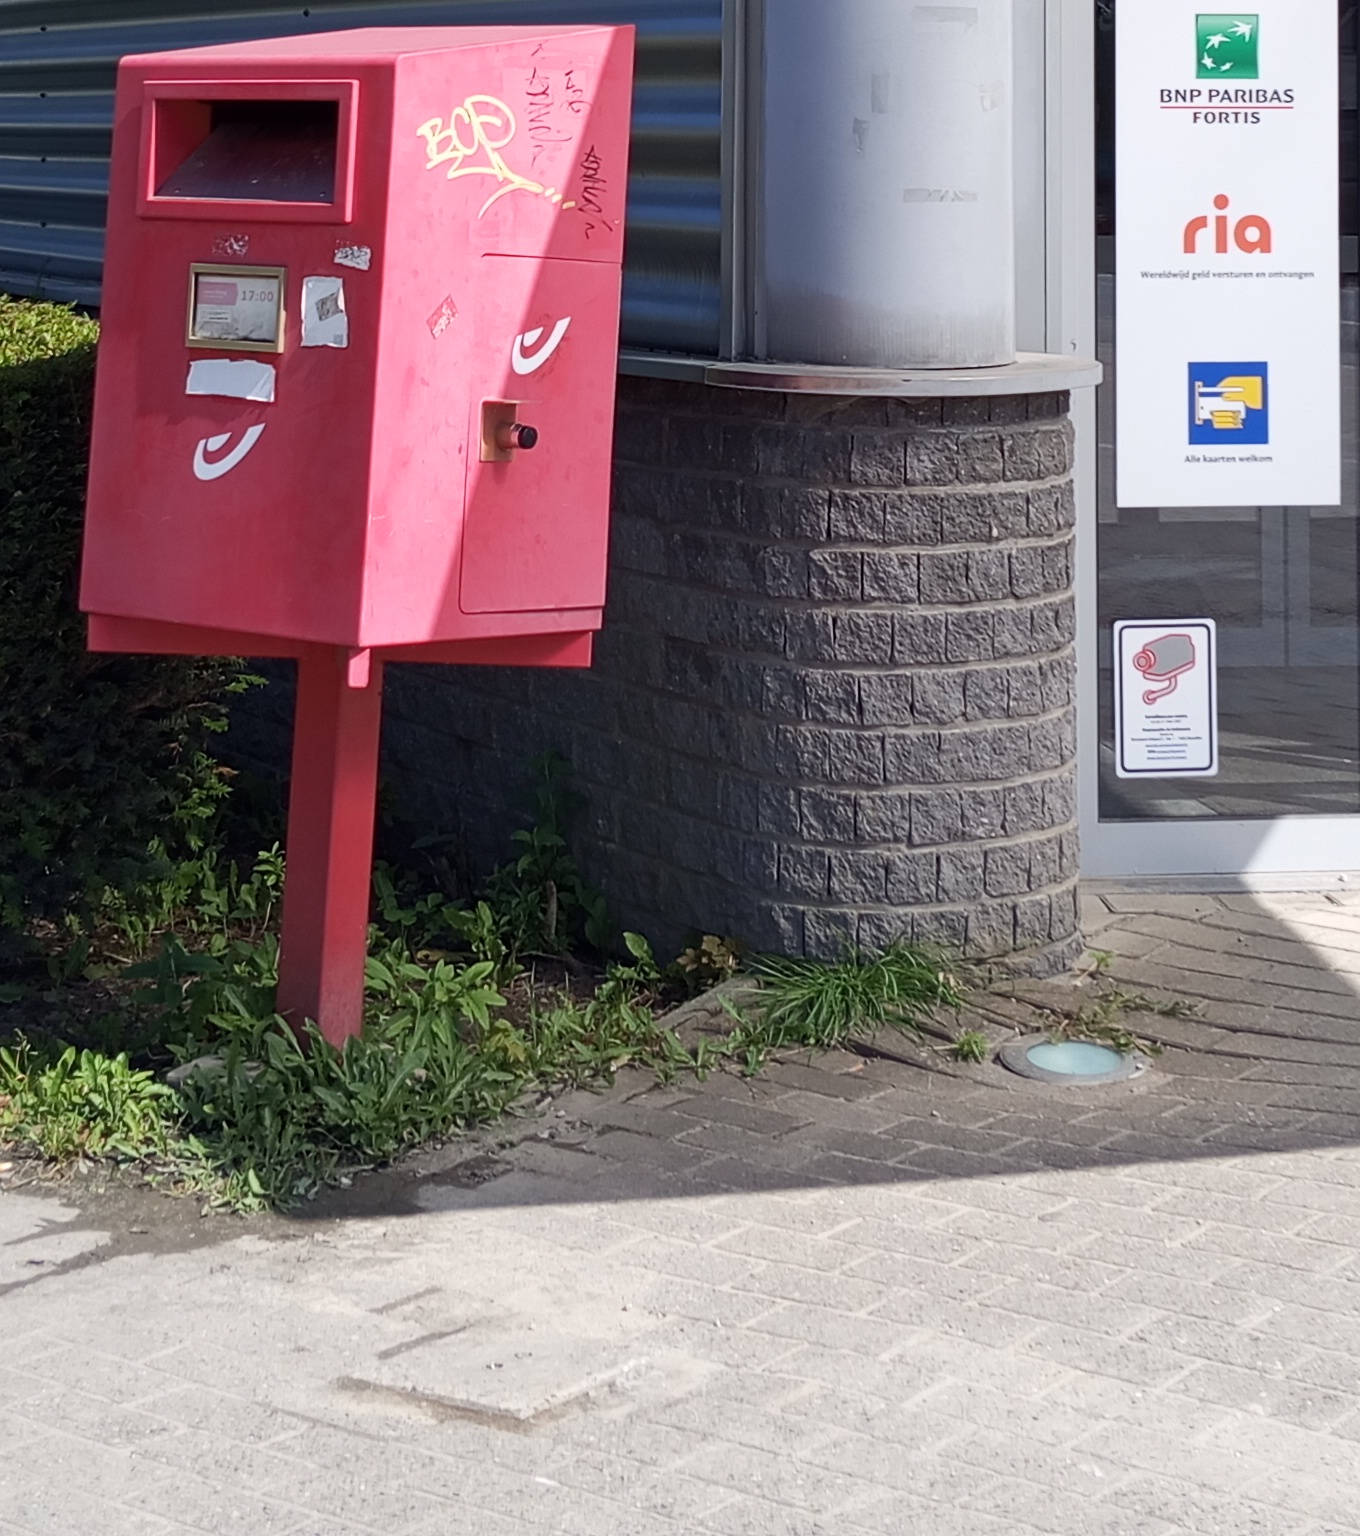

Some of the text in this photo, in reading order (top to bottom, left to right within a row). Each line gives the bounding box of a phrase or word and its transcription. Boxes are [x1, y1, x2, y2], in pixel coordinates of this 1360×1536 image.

[1160, 89, 1295, 103] BNP PARIBAS
[1192, 111, 1261, 124] FORTIS
[1183, 193, 1272, 254] ria
[1140, 270, 1189, 279] Wereldwijd
[1192, 270, 1210, 280] geld
[1212, 271, 1254, 279] versturen
[1268, 271, 1315, 280] ontvangen
[241, 290, 274, 303] 17:00
